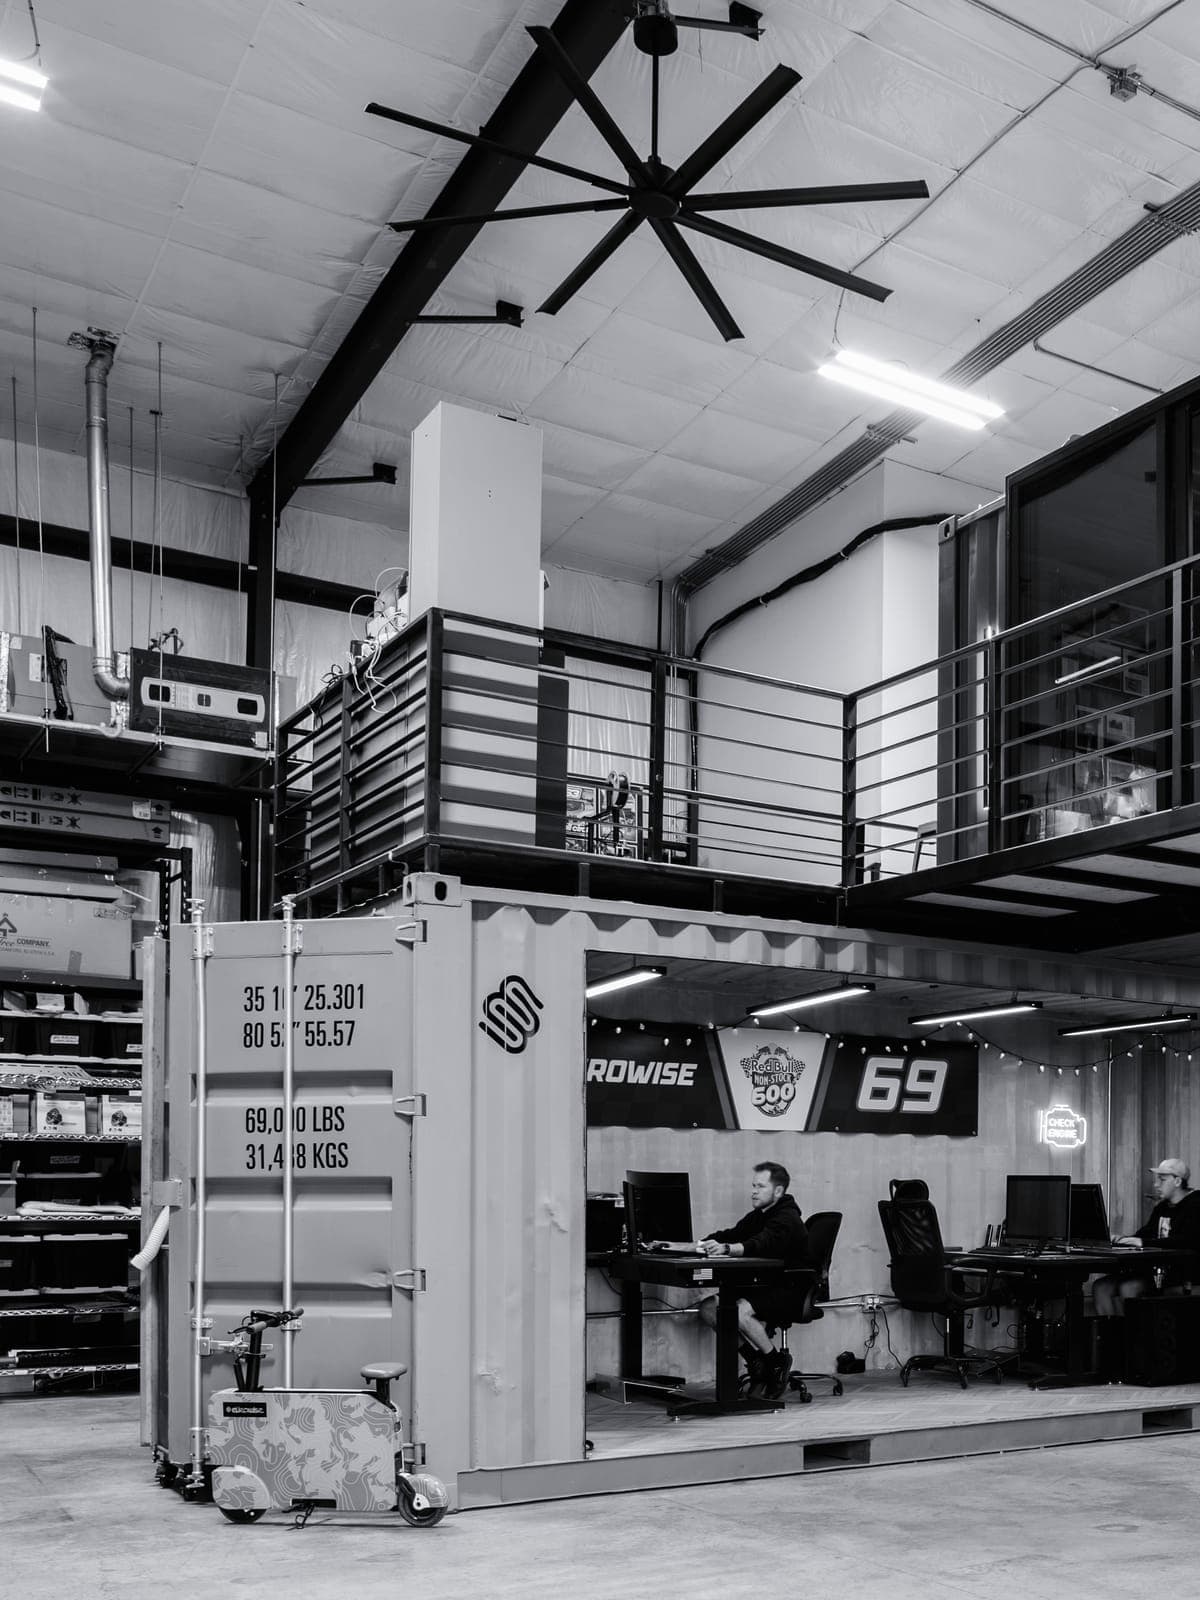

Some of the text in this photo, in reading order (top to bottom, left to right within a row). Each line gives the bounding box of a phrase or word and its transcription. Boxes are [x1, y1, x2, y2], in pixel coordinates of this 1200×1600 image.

[243, 986, 265, 1012] 35
[304, 983, 364, 1011] 25.301
[243, 1022, 264, 1048] 80
[305, 1020, 356, 1047] 55.57
[751, 1060, 794, 1073] Red Bull
[751, 1083, 796, 1107] 600
[857, 1055, 950, 1114] 69
[245, 1106, 345, 1135] 69,00 LBS
[1048, 1118, 1075, 1128] CHECK
[1048, 1128, 1078, 1138] ENGINE
[245, 1142, 349, 1171] 31,48 KGS
